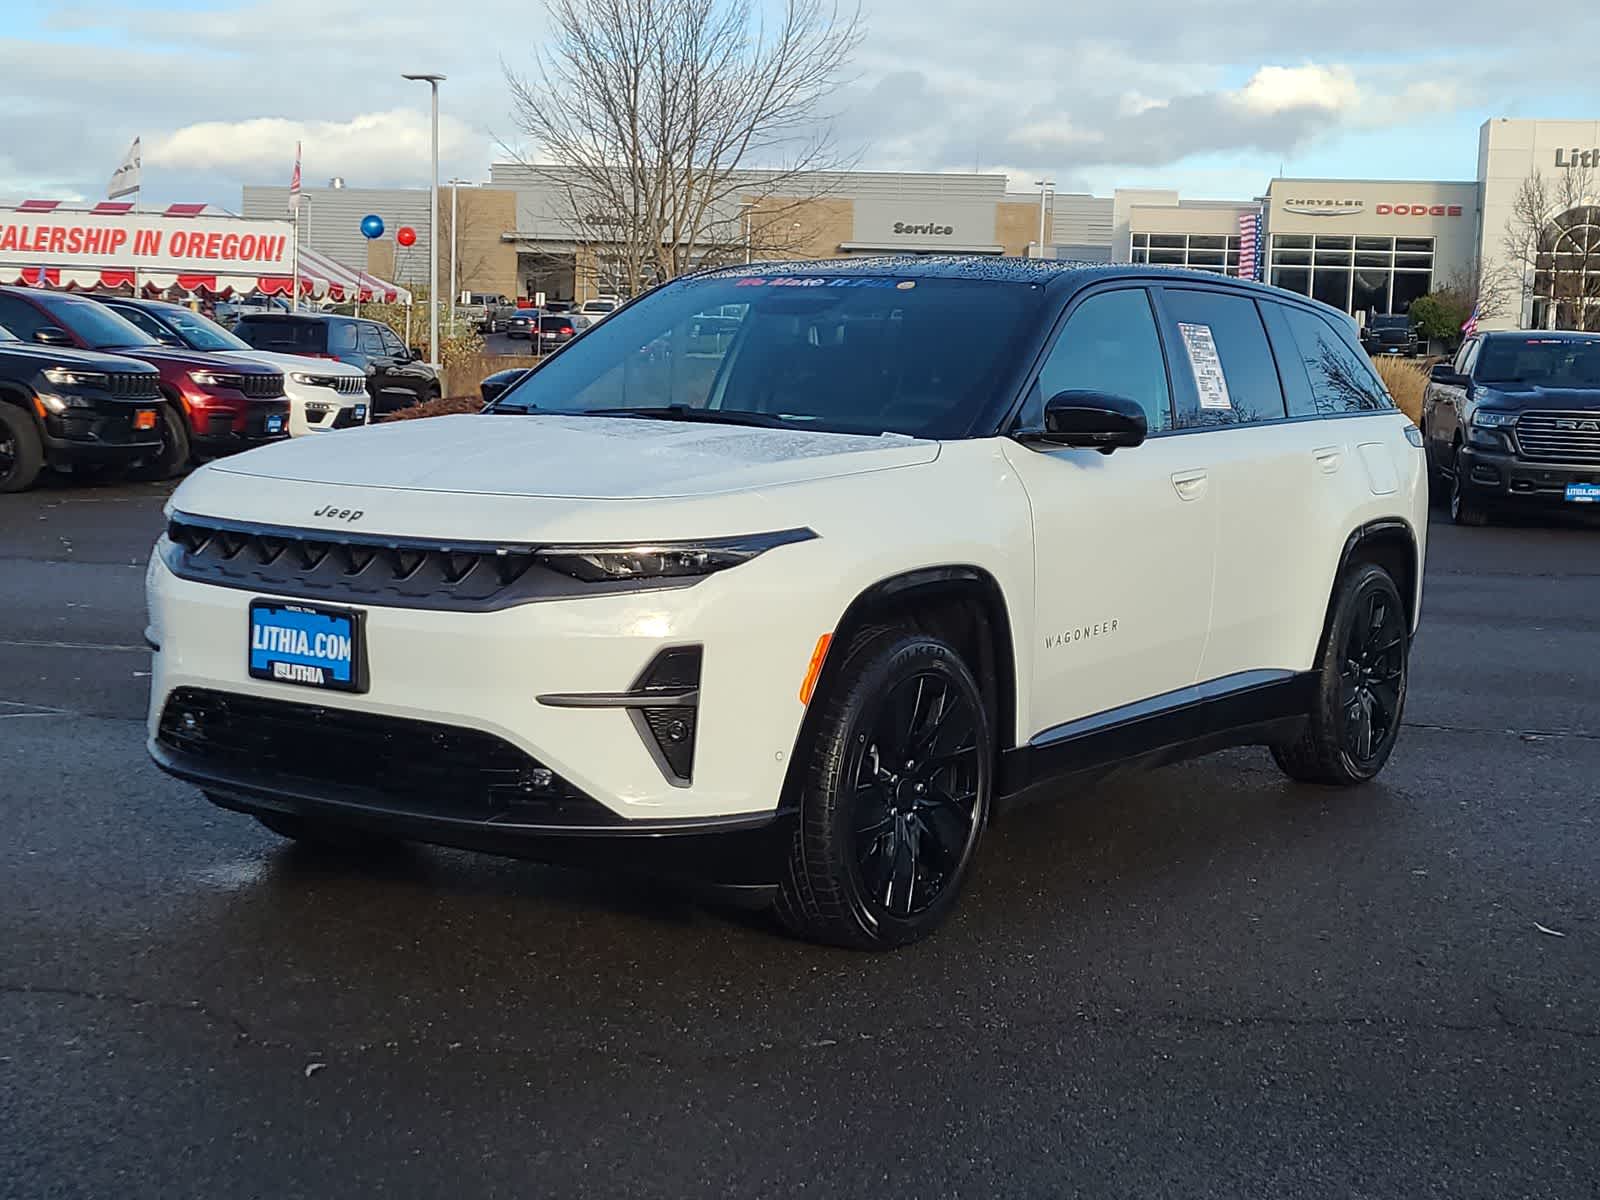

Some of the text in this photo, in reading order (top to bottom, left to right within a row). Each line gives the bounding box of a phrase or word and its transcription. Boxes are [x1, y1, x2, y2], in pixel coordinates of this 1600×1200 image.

[1285, 198, 1364, 206] CHRYSLER
[1376, 204, 1463, 217] DODGE
[893, 222, 954, 236] Service
[0, 224, 286, 262] ALERSHIP IN OREGON!
[313, 504, 365, 523] Jeep
[252, 624, 352, 662] LITHIA.COM
[1045, 619, 1119, 648] WAGONEER
[288, 664, 325, 684] LITHIA
